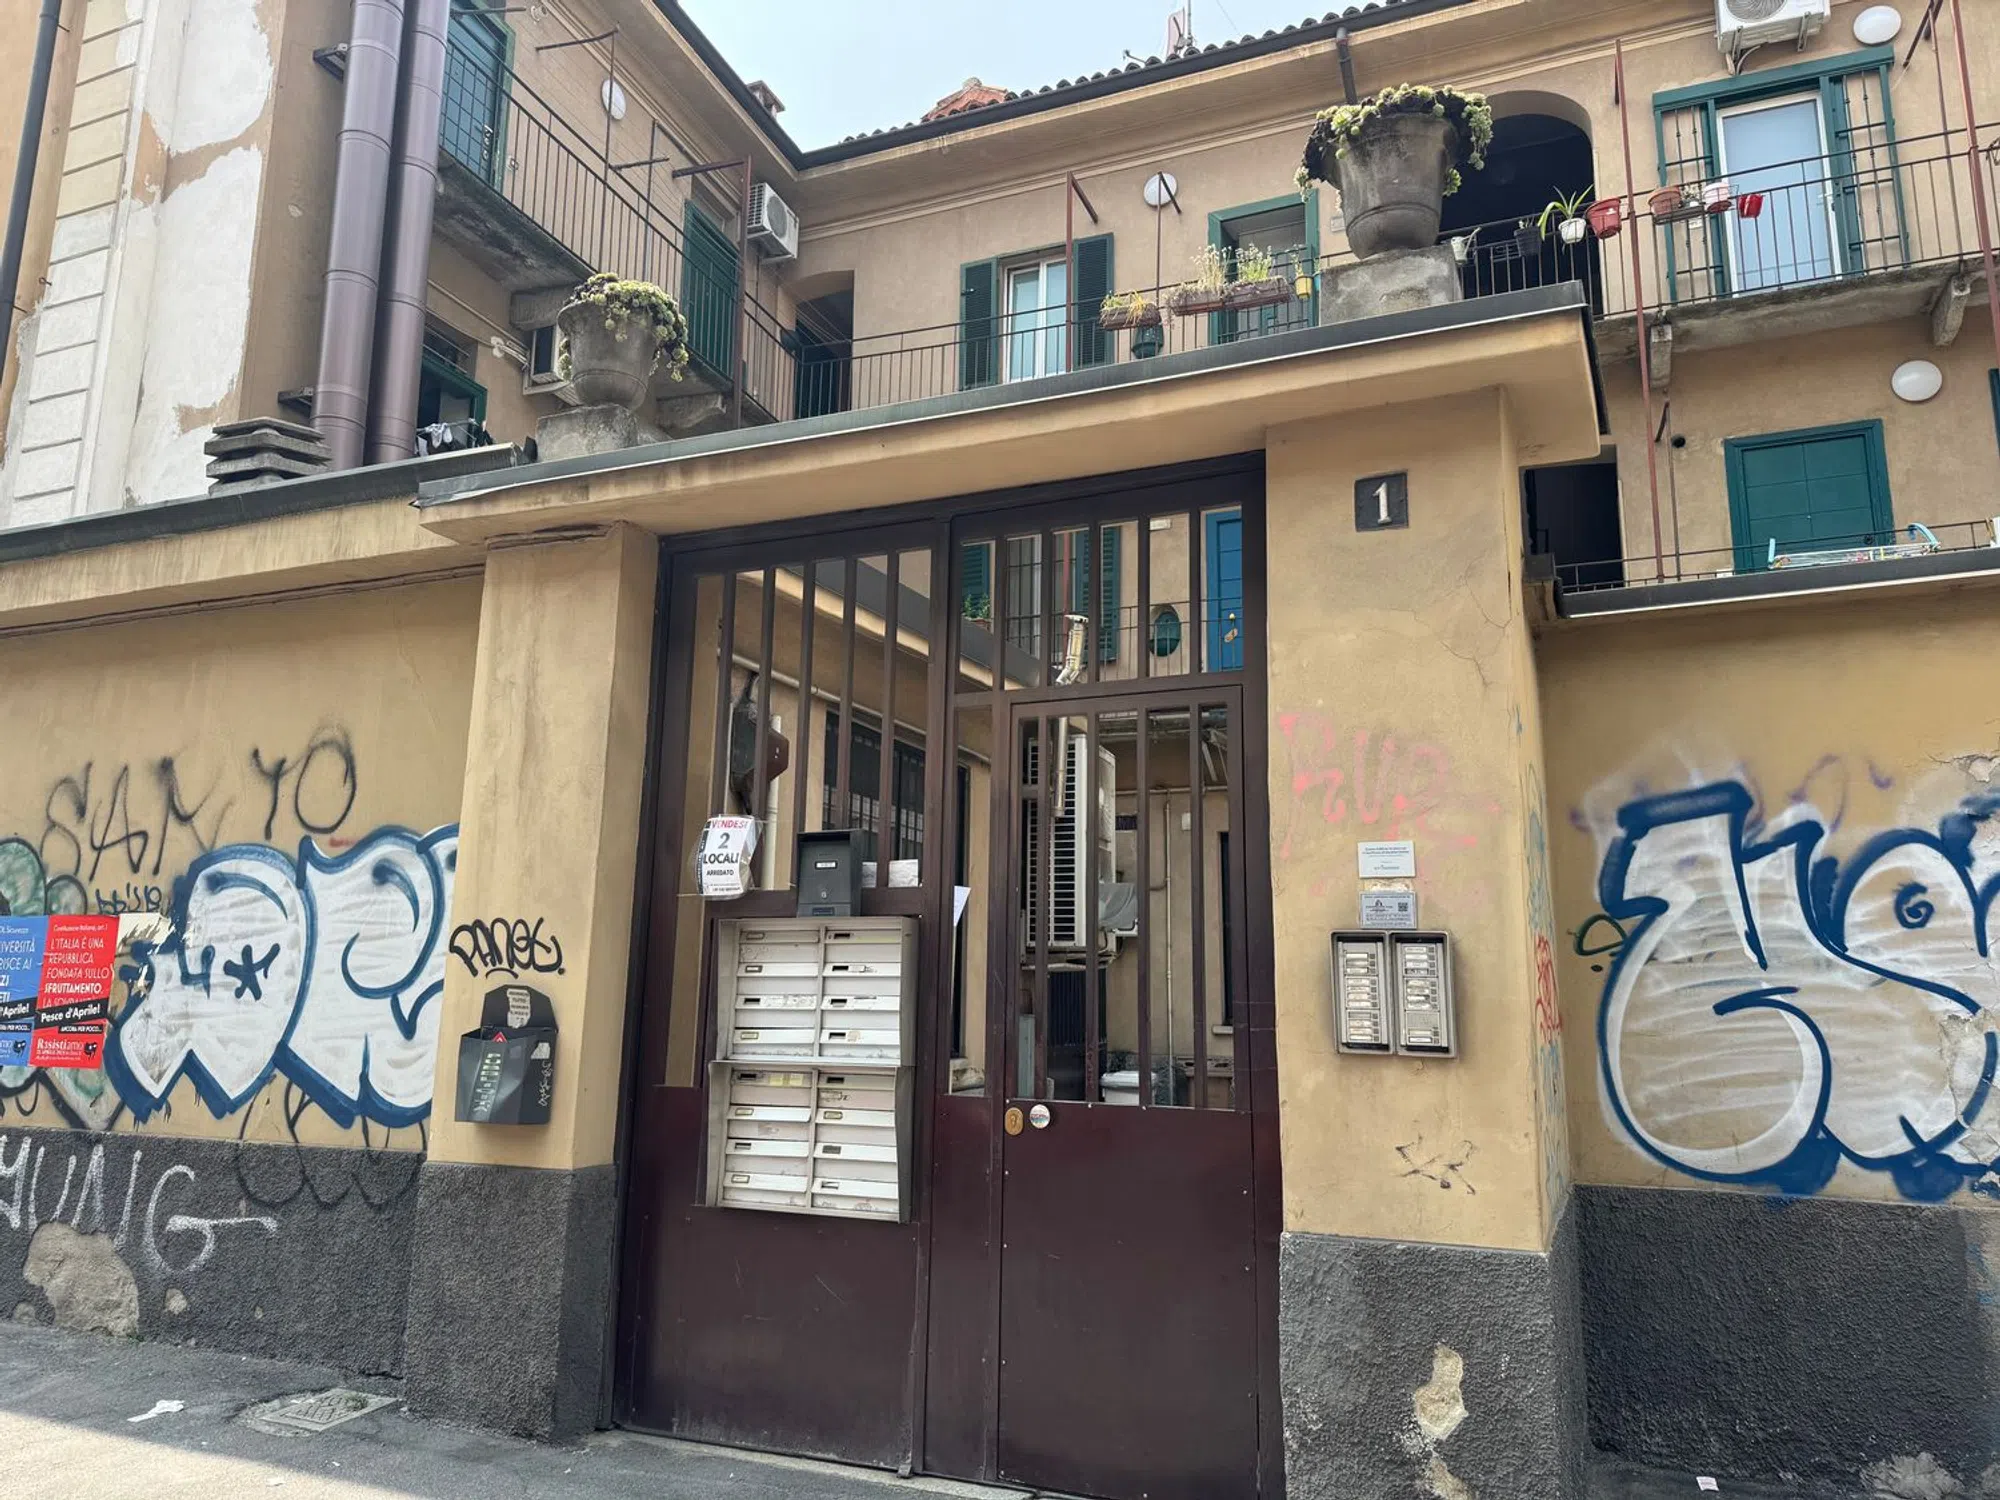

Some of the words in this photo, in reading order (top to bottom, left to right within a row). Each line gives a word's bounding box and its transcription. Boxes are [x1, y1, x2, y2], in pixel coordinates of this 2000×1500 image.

[1372, 481, 1392, 524] 1
[718, 832, 731, 849] 2
[703, 852, 739, 864] LOCALI
[88, 937, 104, 949] UNA
[49, 952, 94, 965] REPUBBLICA
[46, 967, 83, 980] FONDATA
[84, 966, 109, 979] SULLO
[41, 1012, 64, 1023] Pesce
[65, 1003, 100, 1020] d'Aprile!
